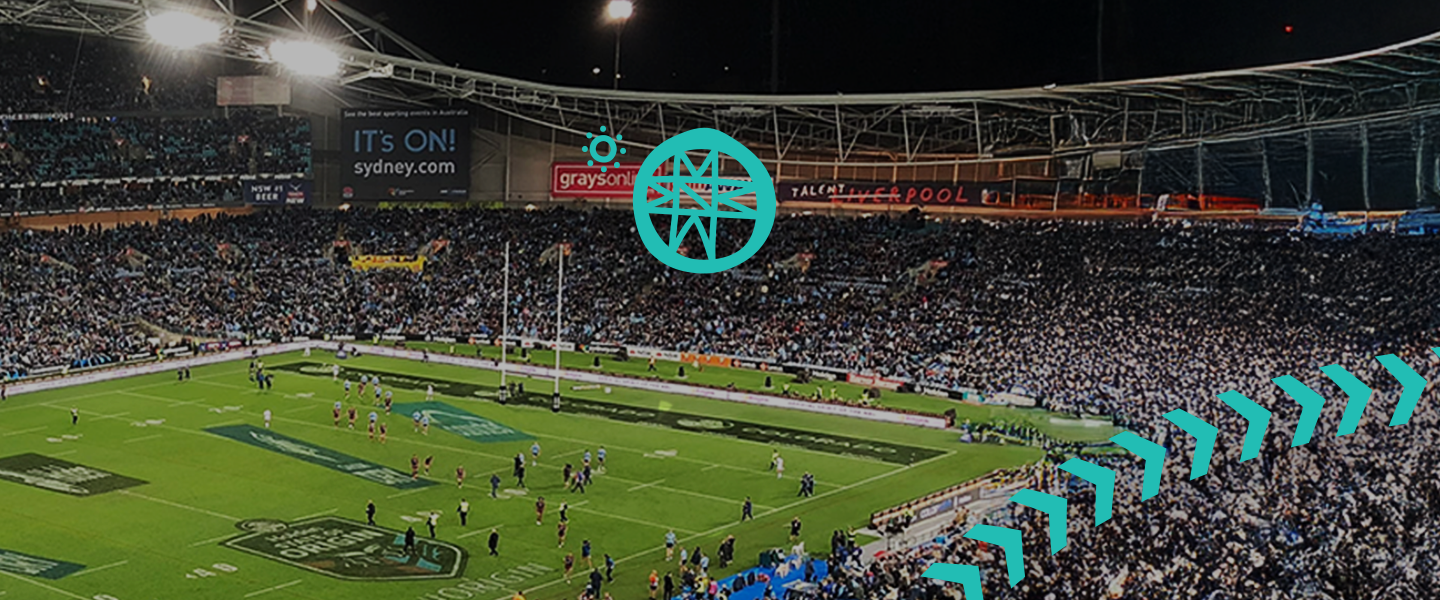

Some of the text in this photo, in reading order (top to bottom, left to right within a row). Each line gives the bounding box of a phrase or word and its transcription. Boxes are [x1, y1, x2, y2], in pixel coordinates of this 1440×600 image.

[404, 128, 456, 153] ON!
[354, 158, 456, 178] sydney.com
[559, 170, 637, 190] graysonli
[255, 193, 279, 201] BEER
[791, 184, 846, 198] TALENT
[280, 529, 384, 559] ORIGIN
